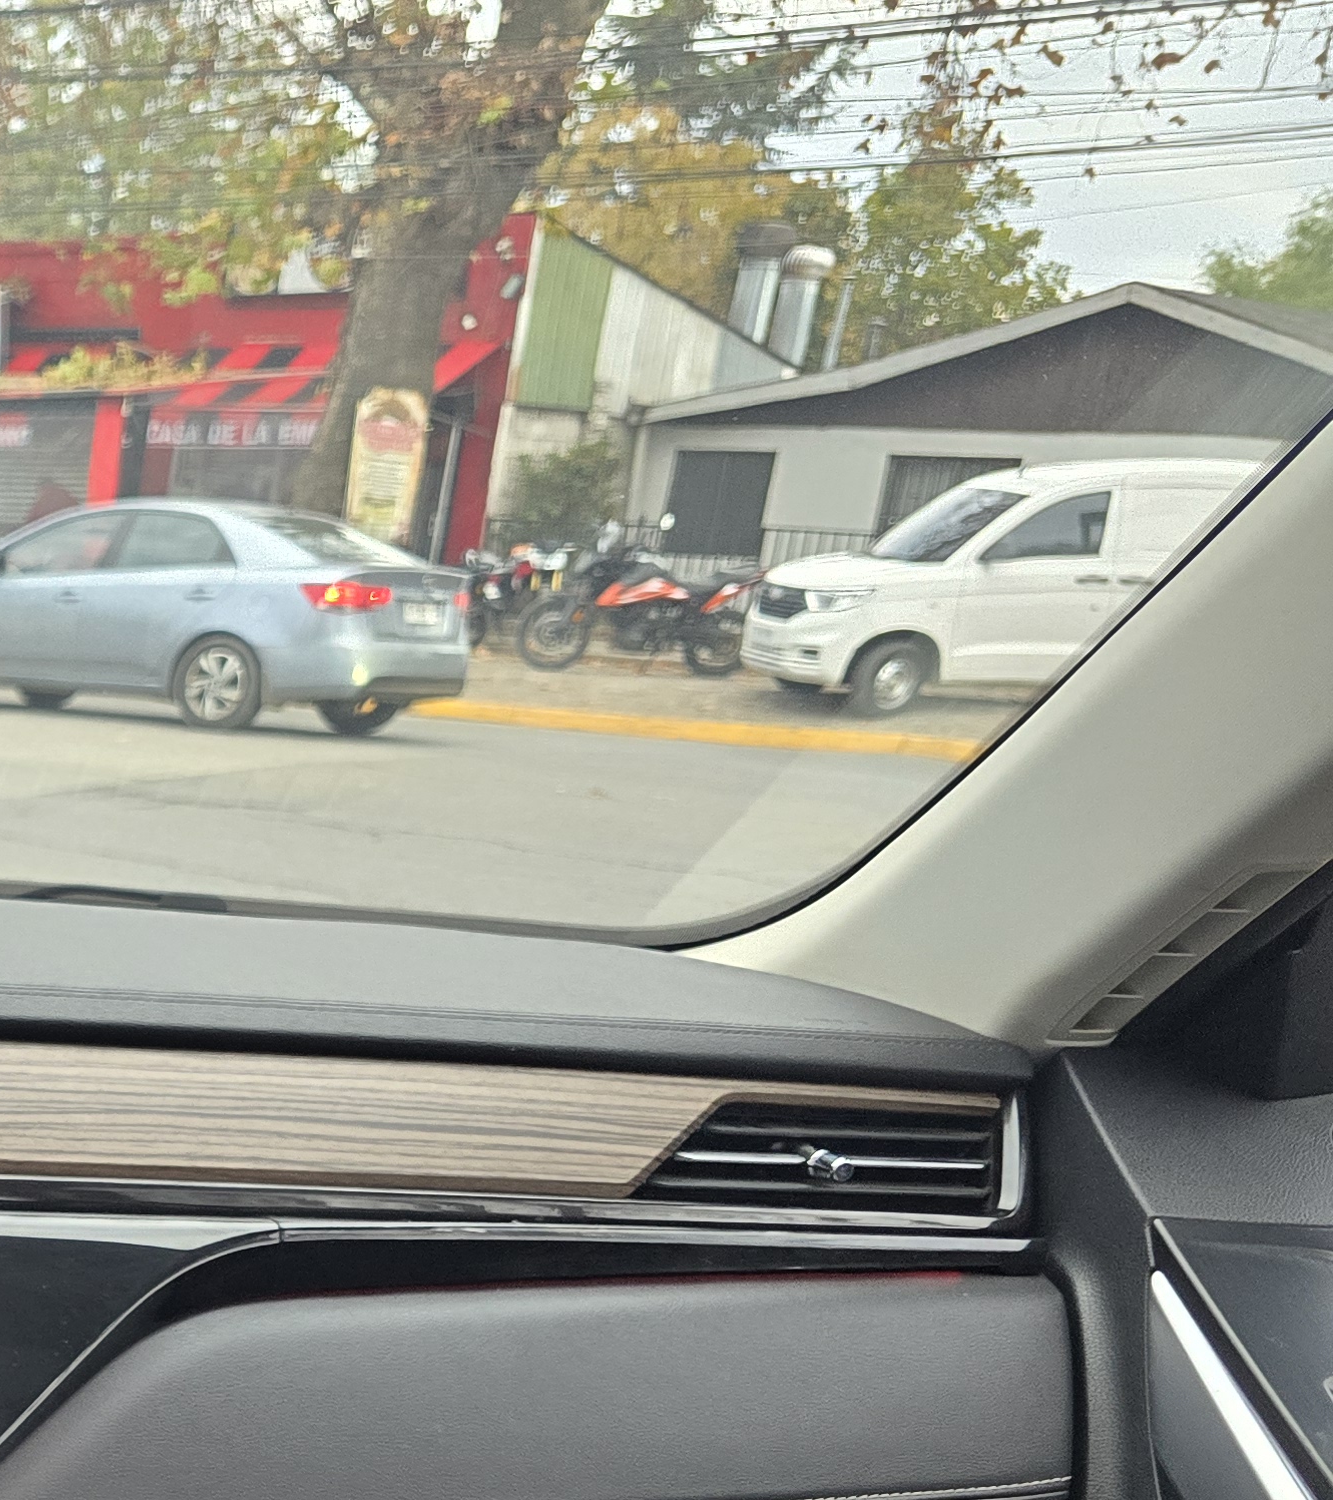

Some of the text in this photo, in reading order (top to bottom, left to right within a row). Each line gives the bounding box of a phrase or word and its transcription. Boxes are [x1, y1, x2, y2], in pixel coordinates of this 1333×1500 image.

[146, 419, 199, 446] CASA
[206, 420, 241, 446] DE
[242, 420, 270, 446] LA
